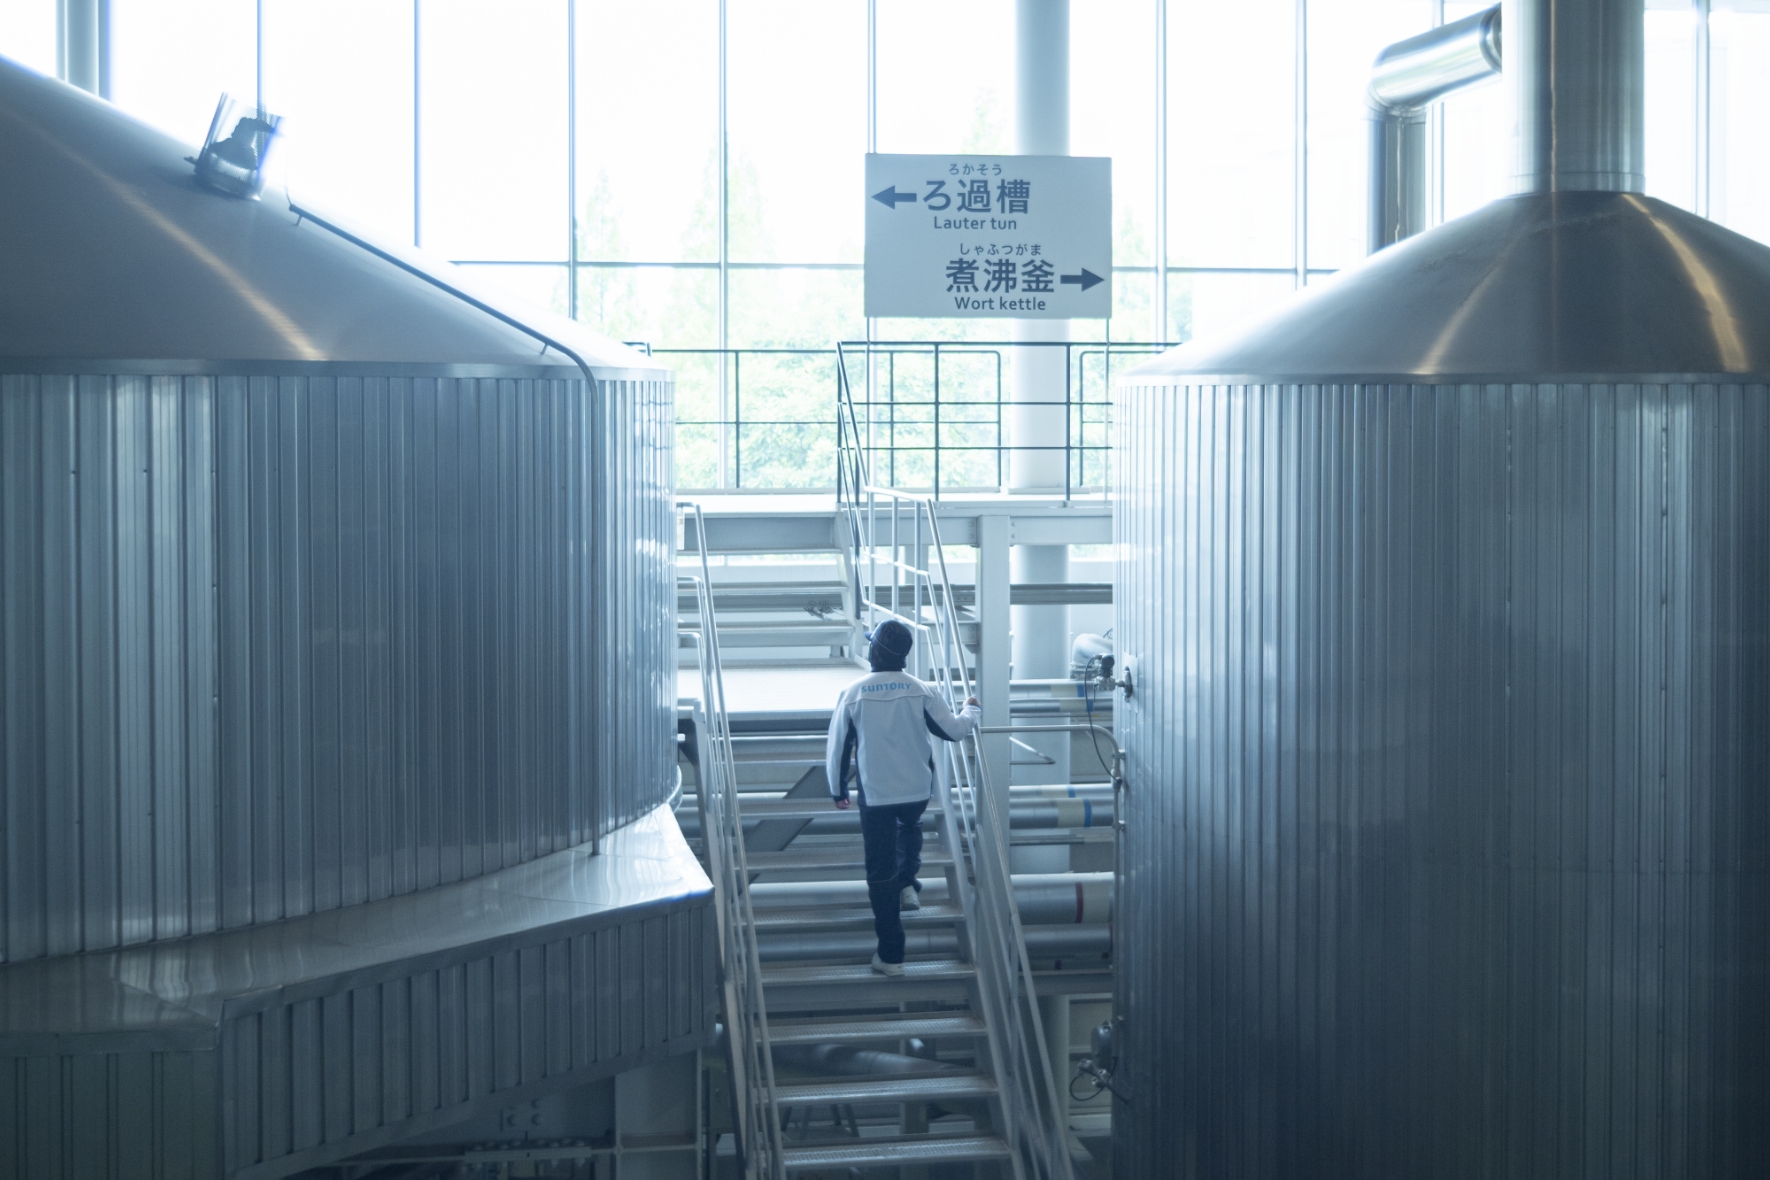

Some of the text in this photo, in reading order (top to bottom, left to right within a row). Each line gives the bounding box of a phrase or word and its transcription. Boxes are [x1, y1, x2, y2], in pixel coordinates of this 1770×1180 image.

[949, 163, 1002, 176] ろかそう
[922, 179, 1031, 214] ろ過槽
[933, 216, 1017, 230] Lauter tun
[959, 243, 1042, 256] しゃふつがま
[945, 258, 1055, 293] 煮沸釜
[954, 296, 1046, 311] Wort kettle
